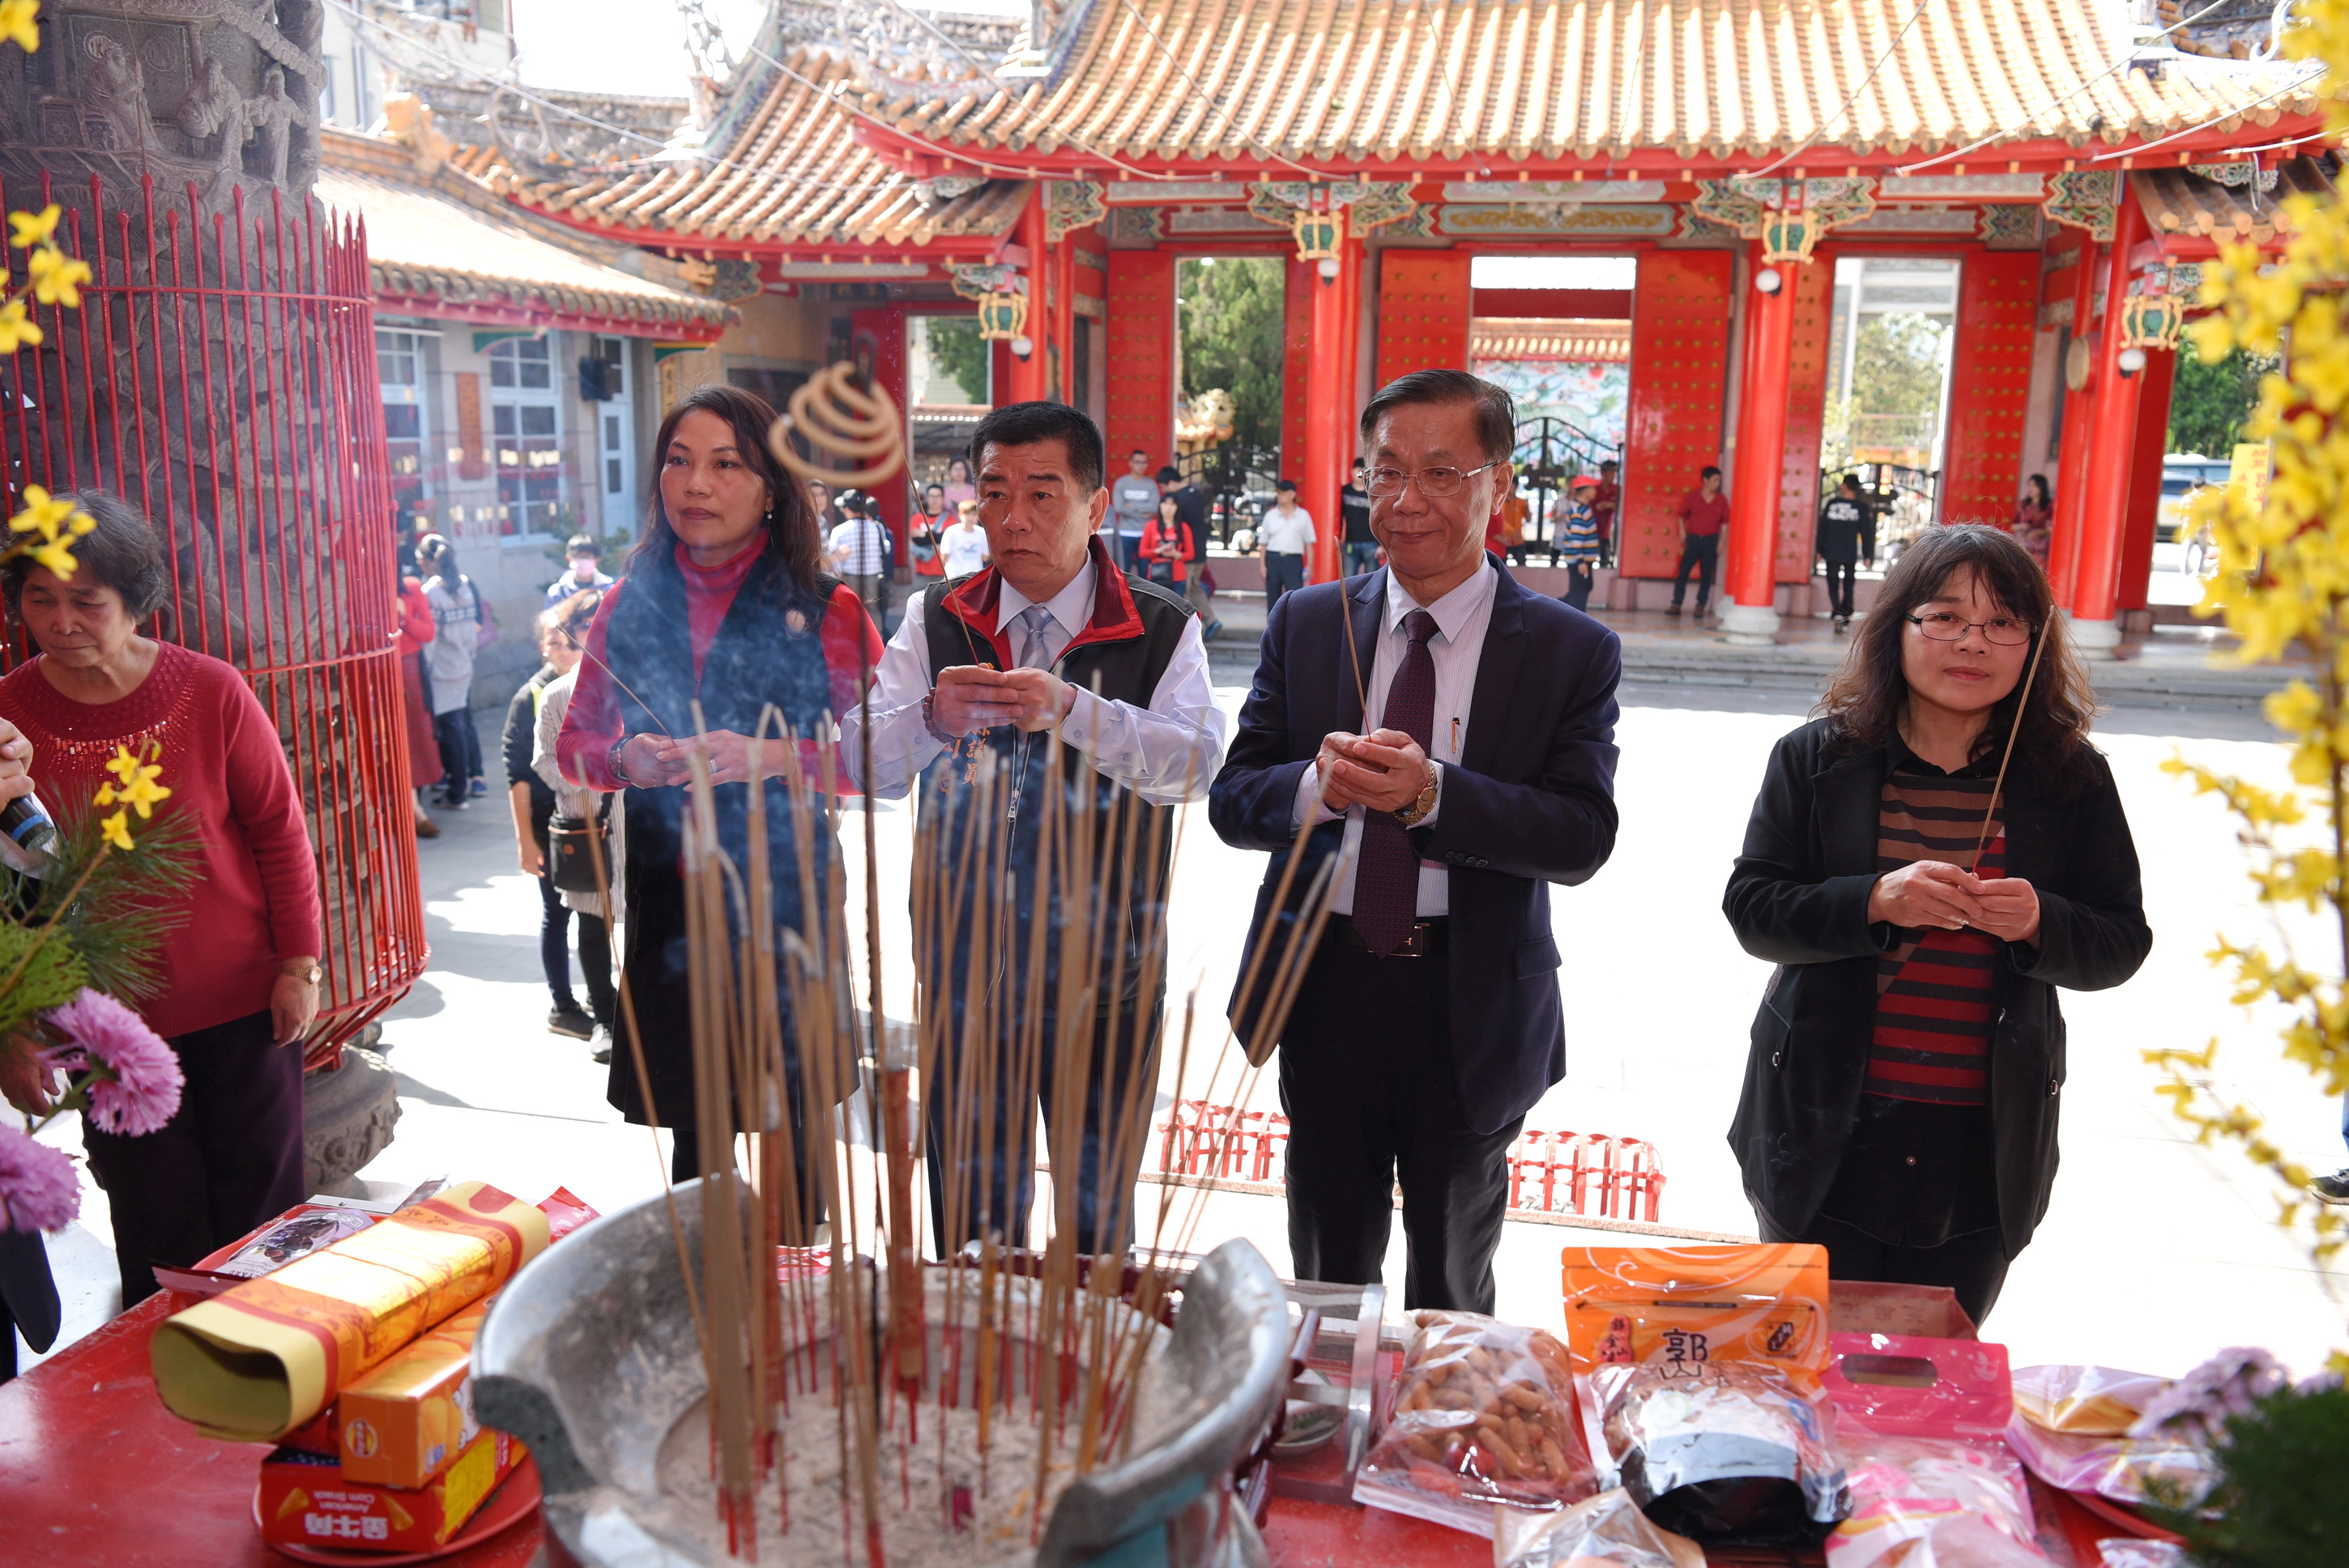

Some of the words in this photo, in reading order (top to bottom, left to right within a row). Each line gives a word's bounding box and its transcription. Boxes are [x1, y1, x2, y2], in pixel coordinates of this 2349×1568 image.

[319, 1502, 370, 1513] American
[305, 1513, 388, 1540] 金牛角
